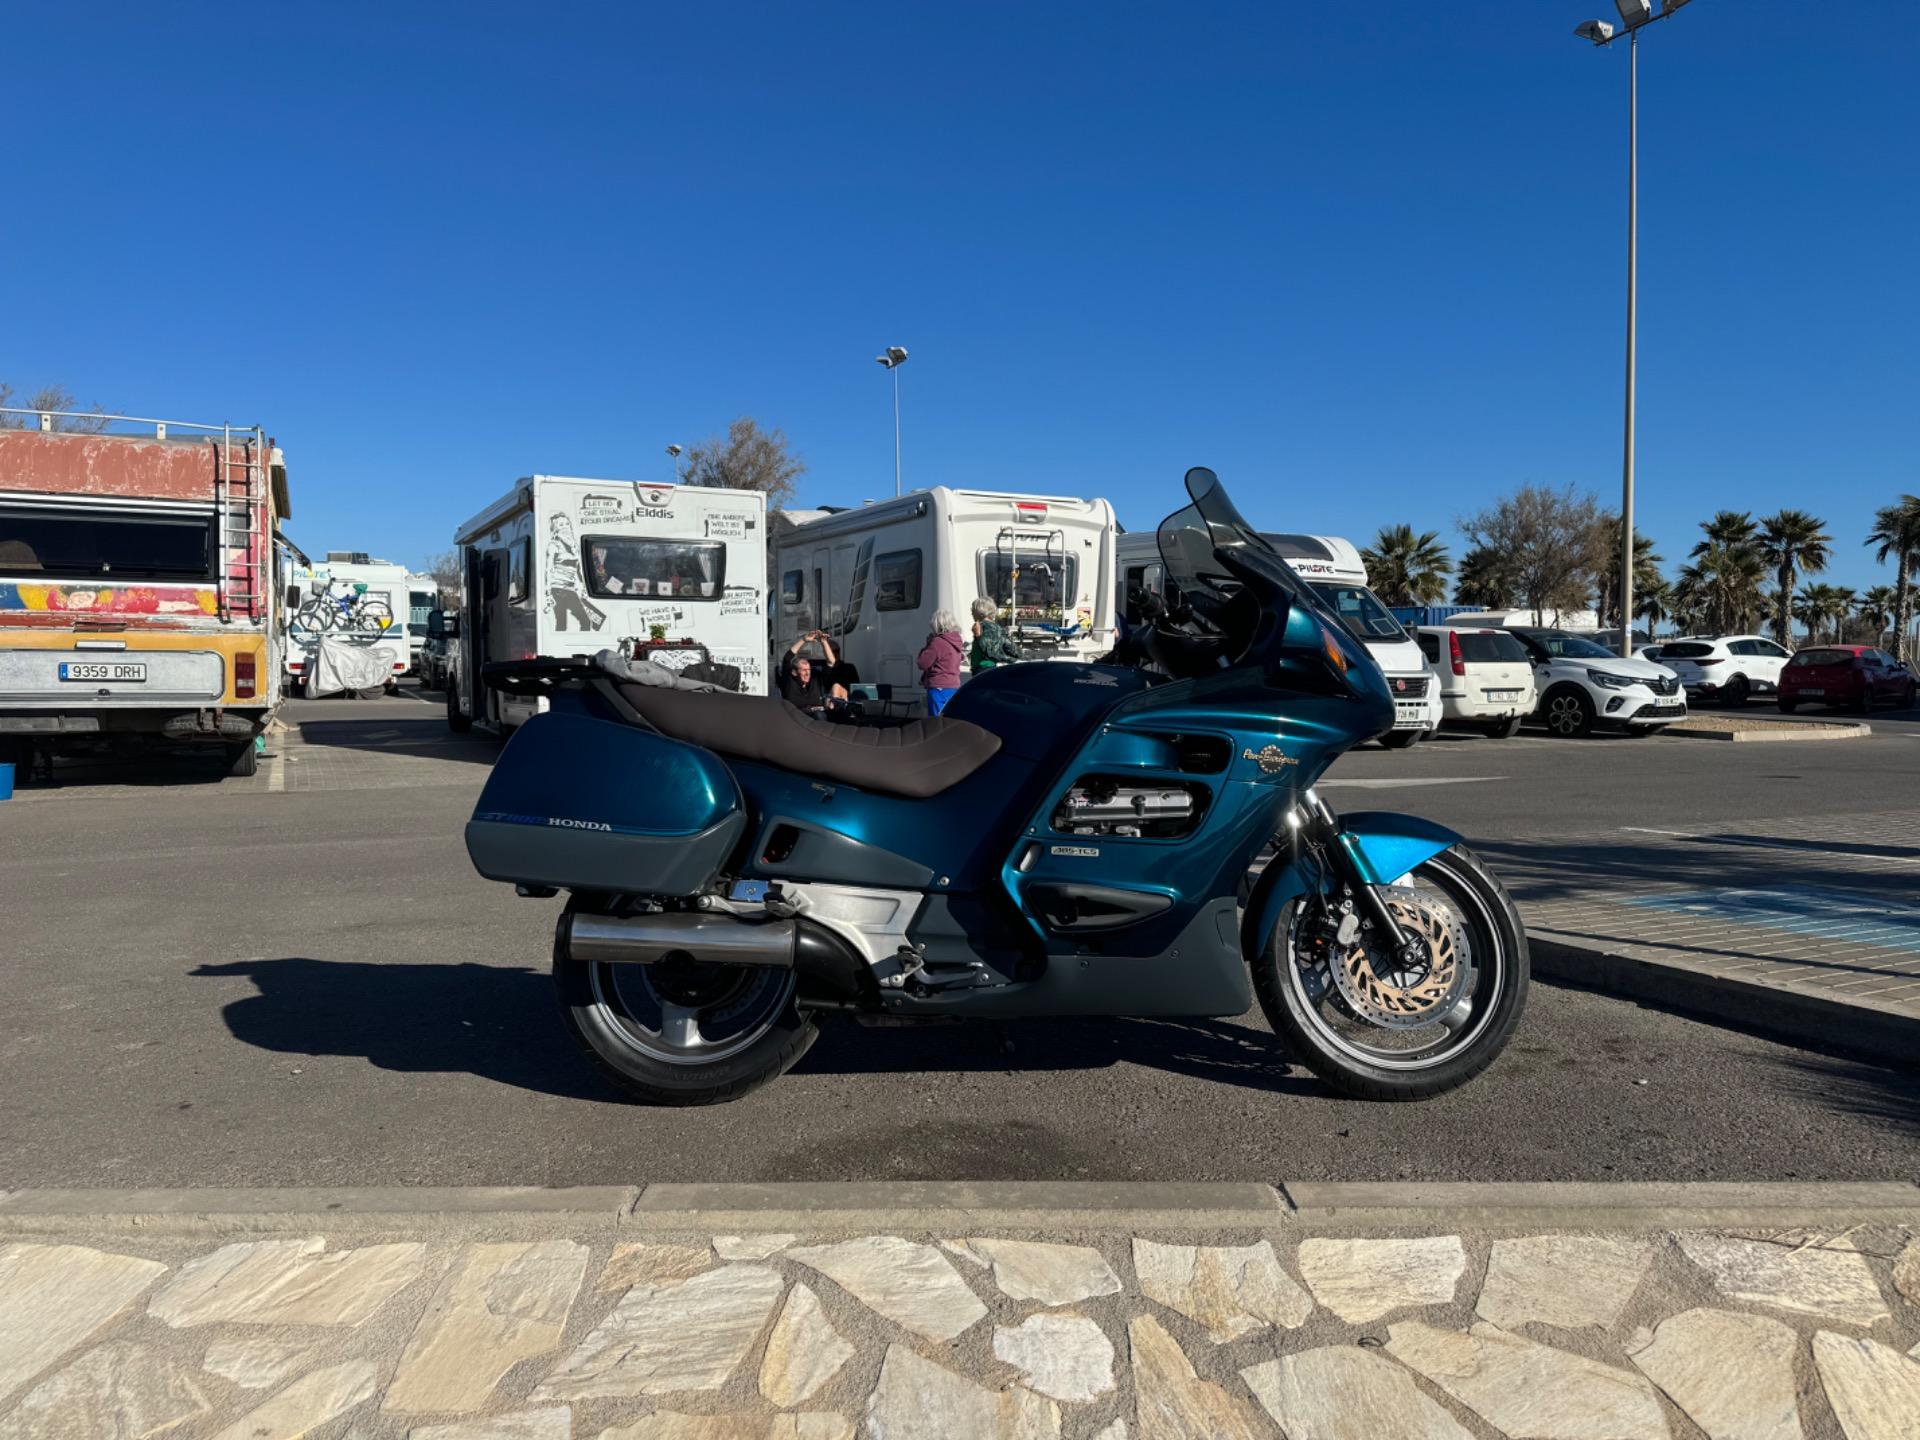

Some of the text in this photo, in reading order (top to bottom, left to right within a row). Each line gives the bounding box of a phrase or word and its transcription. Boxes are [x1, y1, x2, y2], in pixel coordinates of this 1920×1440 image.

[636, 507, 674, 519] Elddis
[73, 665, 141, 678] 9359 DRH
[548, 817, 612, 831] HONDA
